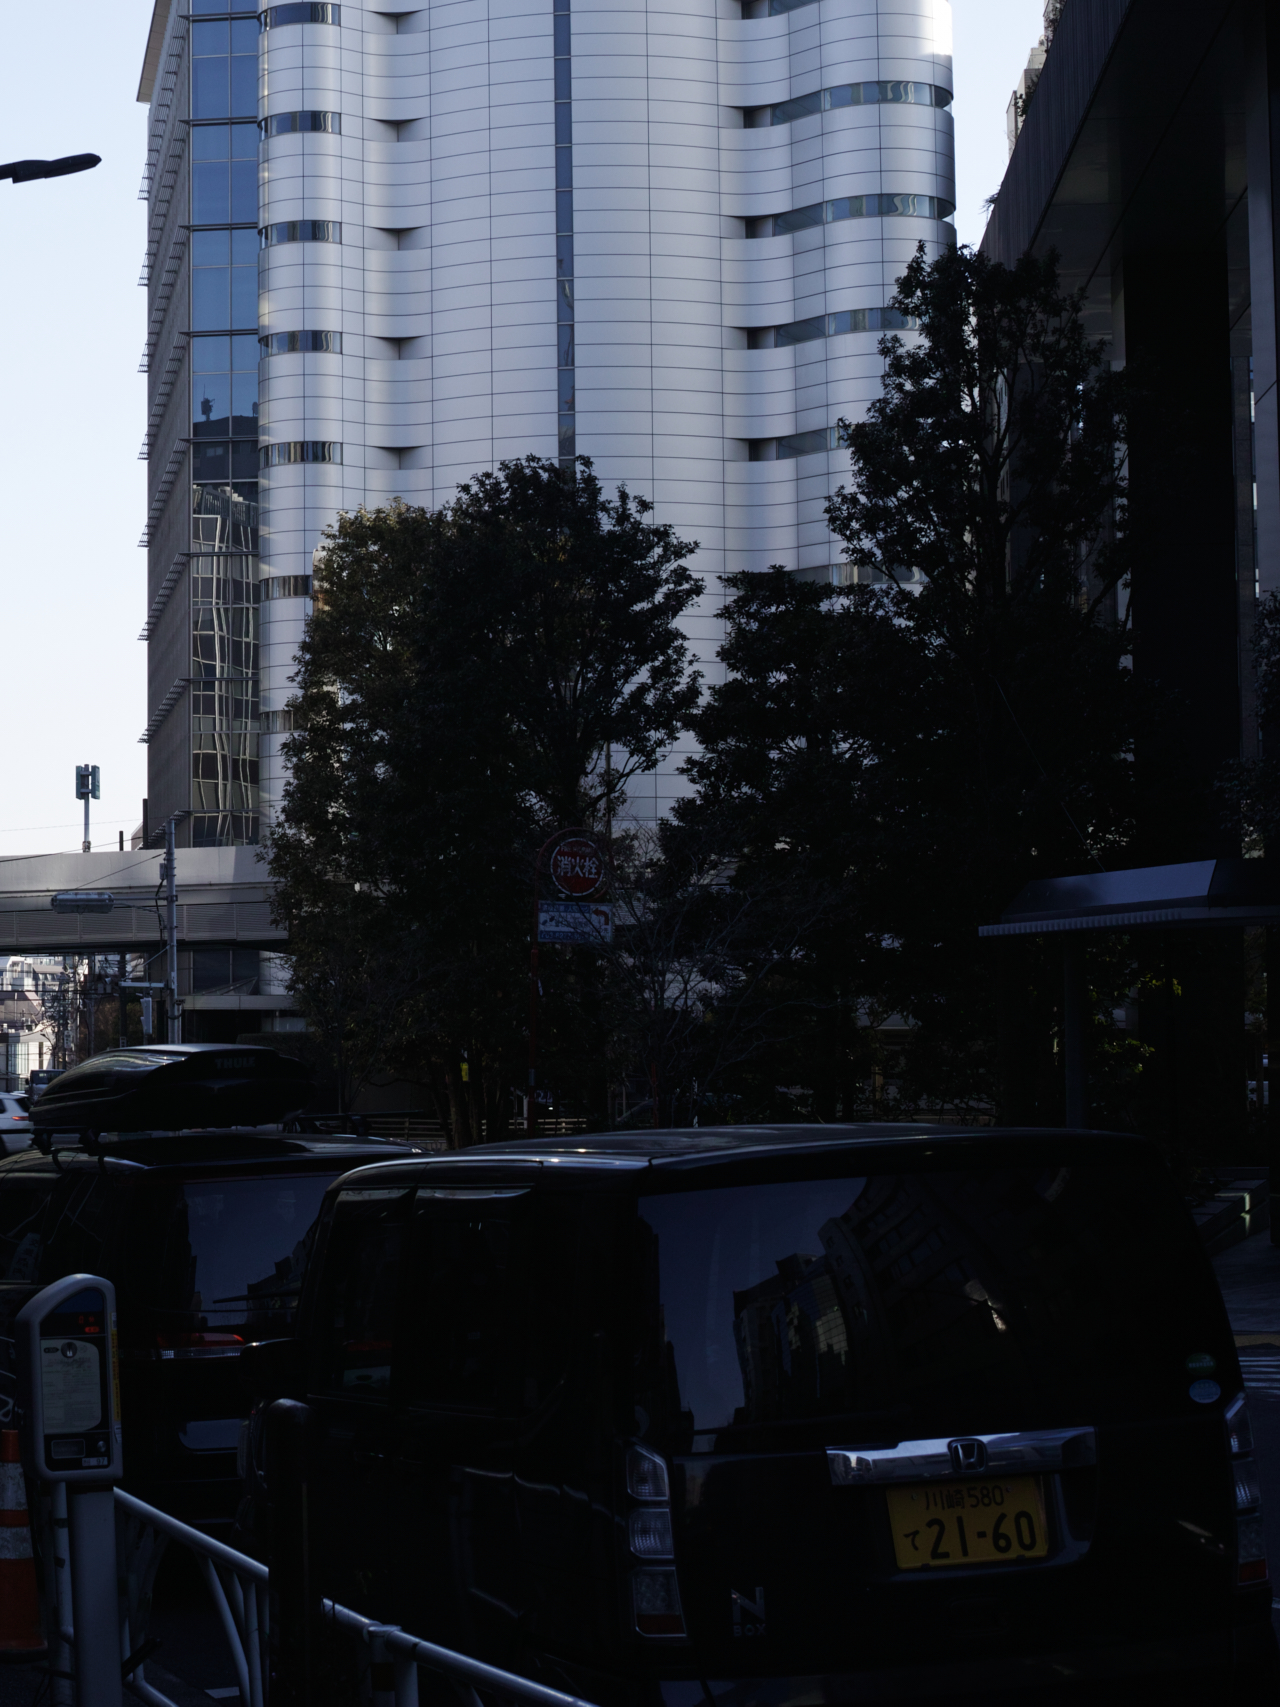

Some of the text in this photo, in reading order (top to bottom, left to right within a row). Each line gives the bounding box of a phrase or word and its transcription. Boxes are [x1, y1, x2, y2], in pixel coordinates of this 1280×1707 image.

[556, 855, 599, 879] 消火栓
[214, 1056, 256, 1069] THULE
[96, 1457, 106, 1466] 97
[924, 1484, 1005, 1511] 川崎 580
[904, 1510, 1037, 1560] て 21-60
[733, 1623, 767, 1637] BOX
